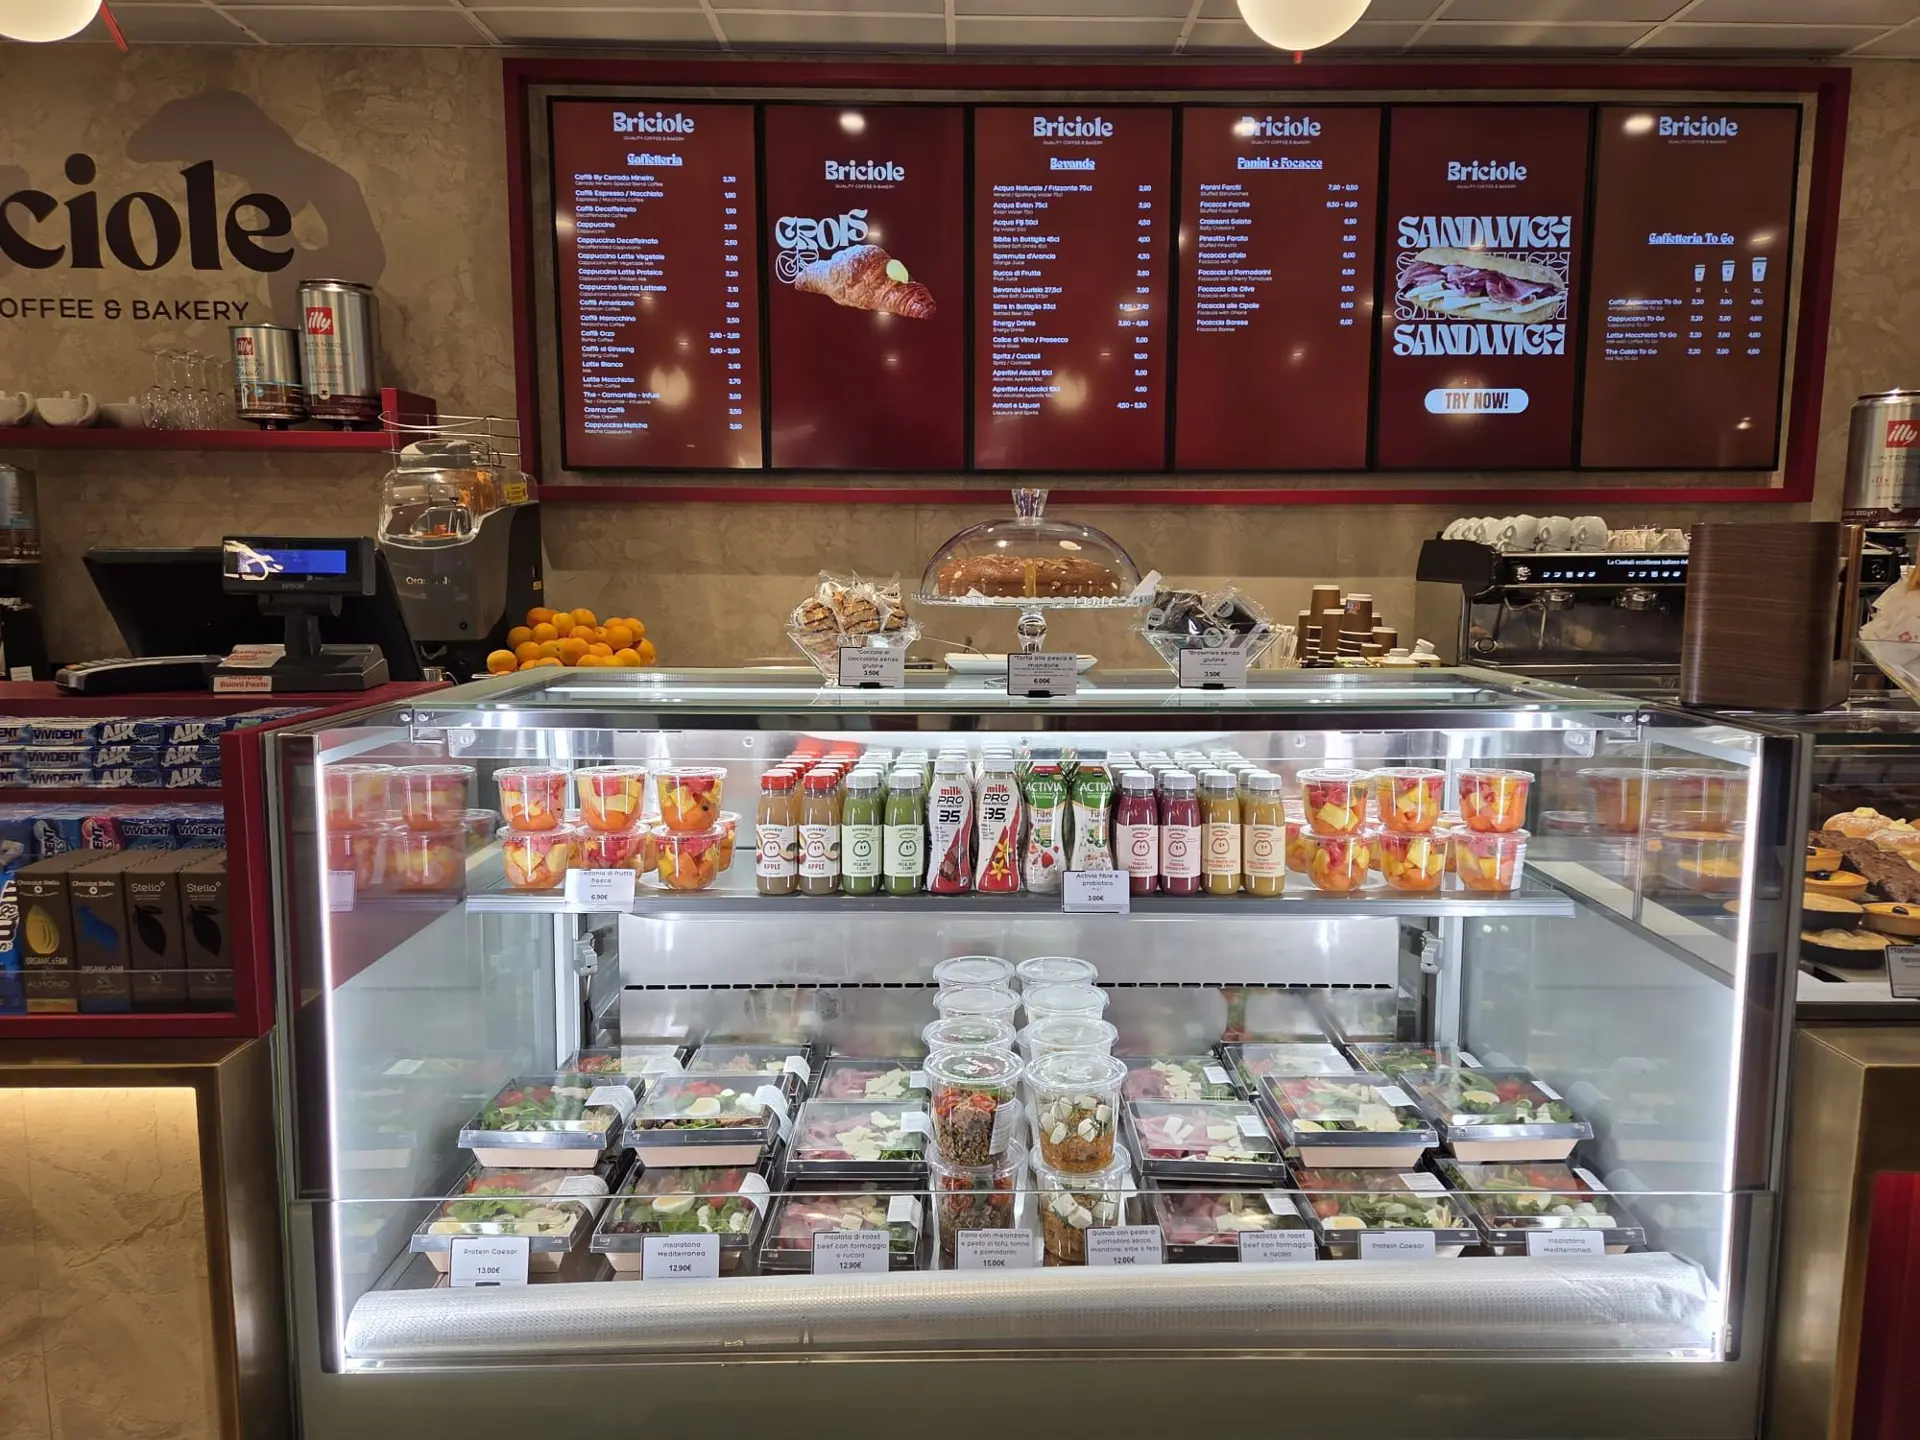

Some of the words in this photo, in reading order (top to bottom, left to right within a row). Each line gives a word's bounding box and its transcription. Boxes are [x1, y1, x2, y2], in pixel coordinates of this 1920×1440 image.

[613, 111, 695, 133] Briciole
[1033, 116, 1114, 137] Briciole
[1659, 116, 1738, 136] Briciole
[627, 153, 683, 166] Caffetteria
[1050, 158, 1096, 170] Bevande
[1237, 157, 1270, 169] Panini
[1281, 157, 1323, 169] Focacce
[825, 160, 905, 181] Briciole
[1447, 161, 1528, 181] Briciole
[0, 153, 295, 272] ciole
[775, 209, 869, 250] CROIS
[1397, 216, 1572, 248] SANDWICH
[1649, 232, 1703, 245] Caffetteria
[1706, 233, 1719, 244] To
[1720, 233, 1735, 245] Go
[0, 298, 94, 319] OFFEE
[105, 300, 121, 320] &
[132, 300, 250, 322] BAKERY
[308, 311, 331, 333] illy
[238, 340, 252, 354] illy
[1393, 324, 1566, 356] SANDWICH
[1445, 392, 1469, 410] TRY
[1473, 392, 1509, 410] NOW!
[1887, 424, 1918, 446] illy
[220, 680, 244, 688] Buoni
[101, 723, 136, 739] AIR
[173, 723, 206, 739] AIR
[97, 746, 132, 762] AIR
[165, 746, 200, 762] AIR
[102, 768, 133, 785] AIR
[169, 768, 203, 786] AIR
[940, 786, 962, 795] milk
[986, 784, 1009, 793] milk
[1025, 782, 1063, 792] ACTIVIA
[938, 796, 964, 804] PRO
[983, 793, 1010, 802] PRO
[939, 810, 961, 823] 35
[131, 883, 161, 893] Stella
[186, 883, 217, 893] Stella
[27, 980, 70, 988] ALMOND
[669, 1264, 692, 1272] 12.90€
